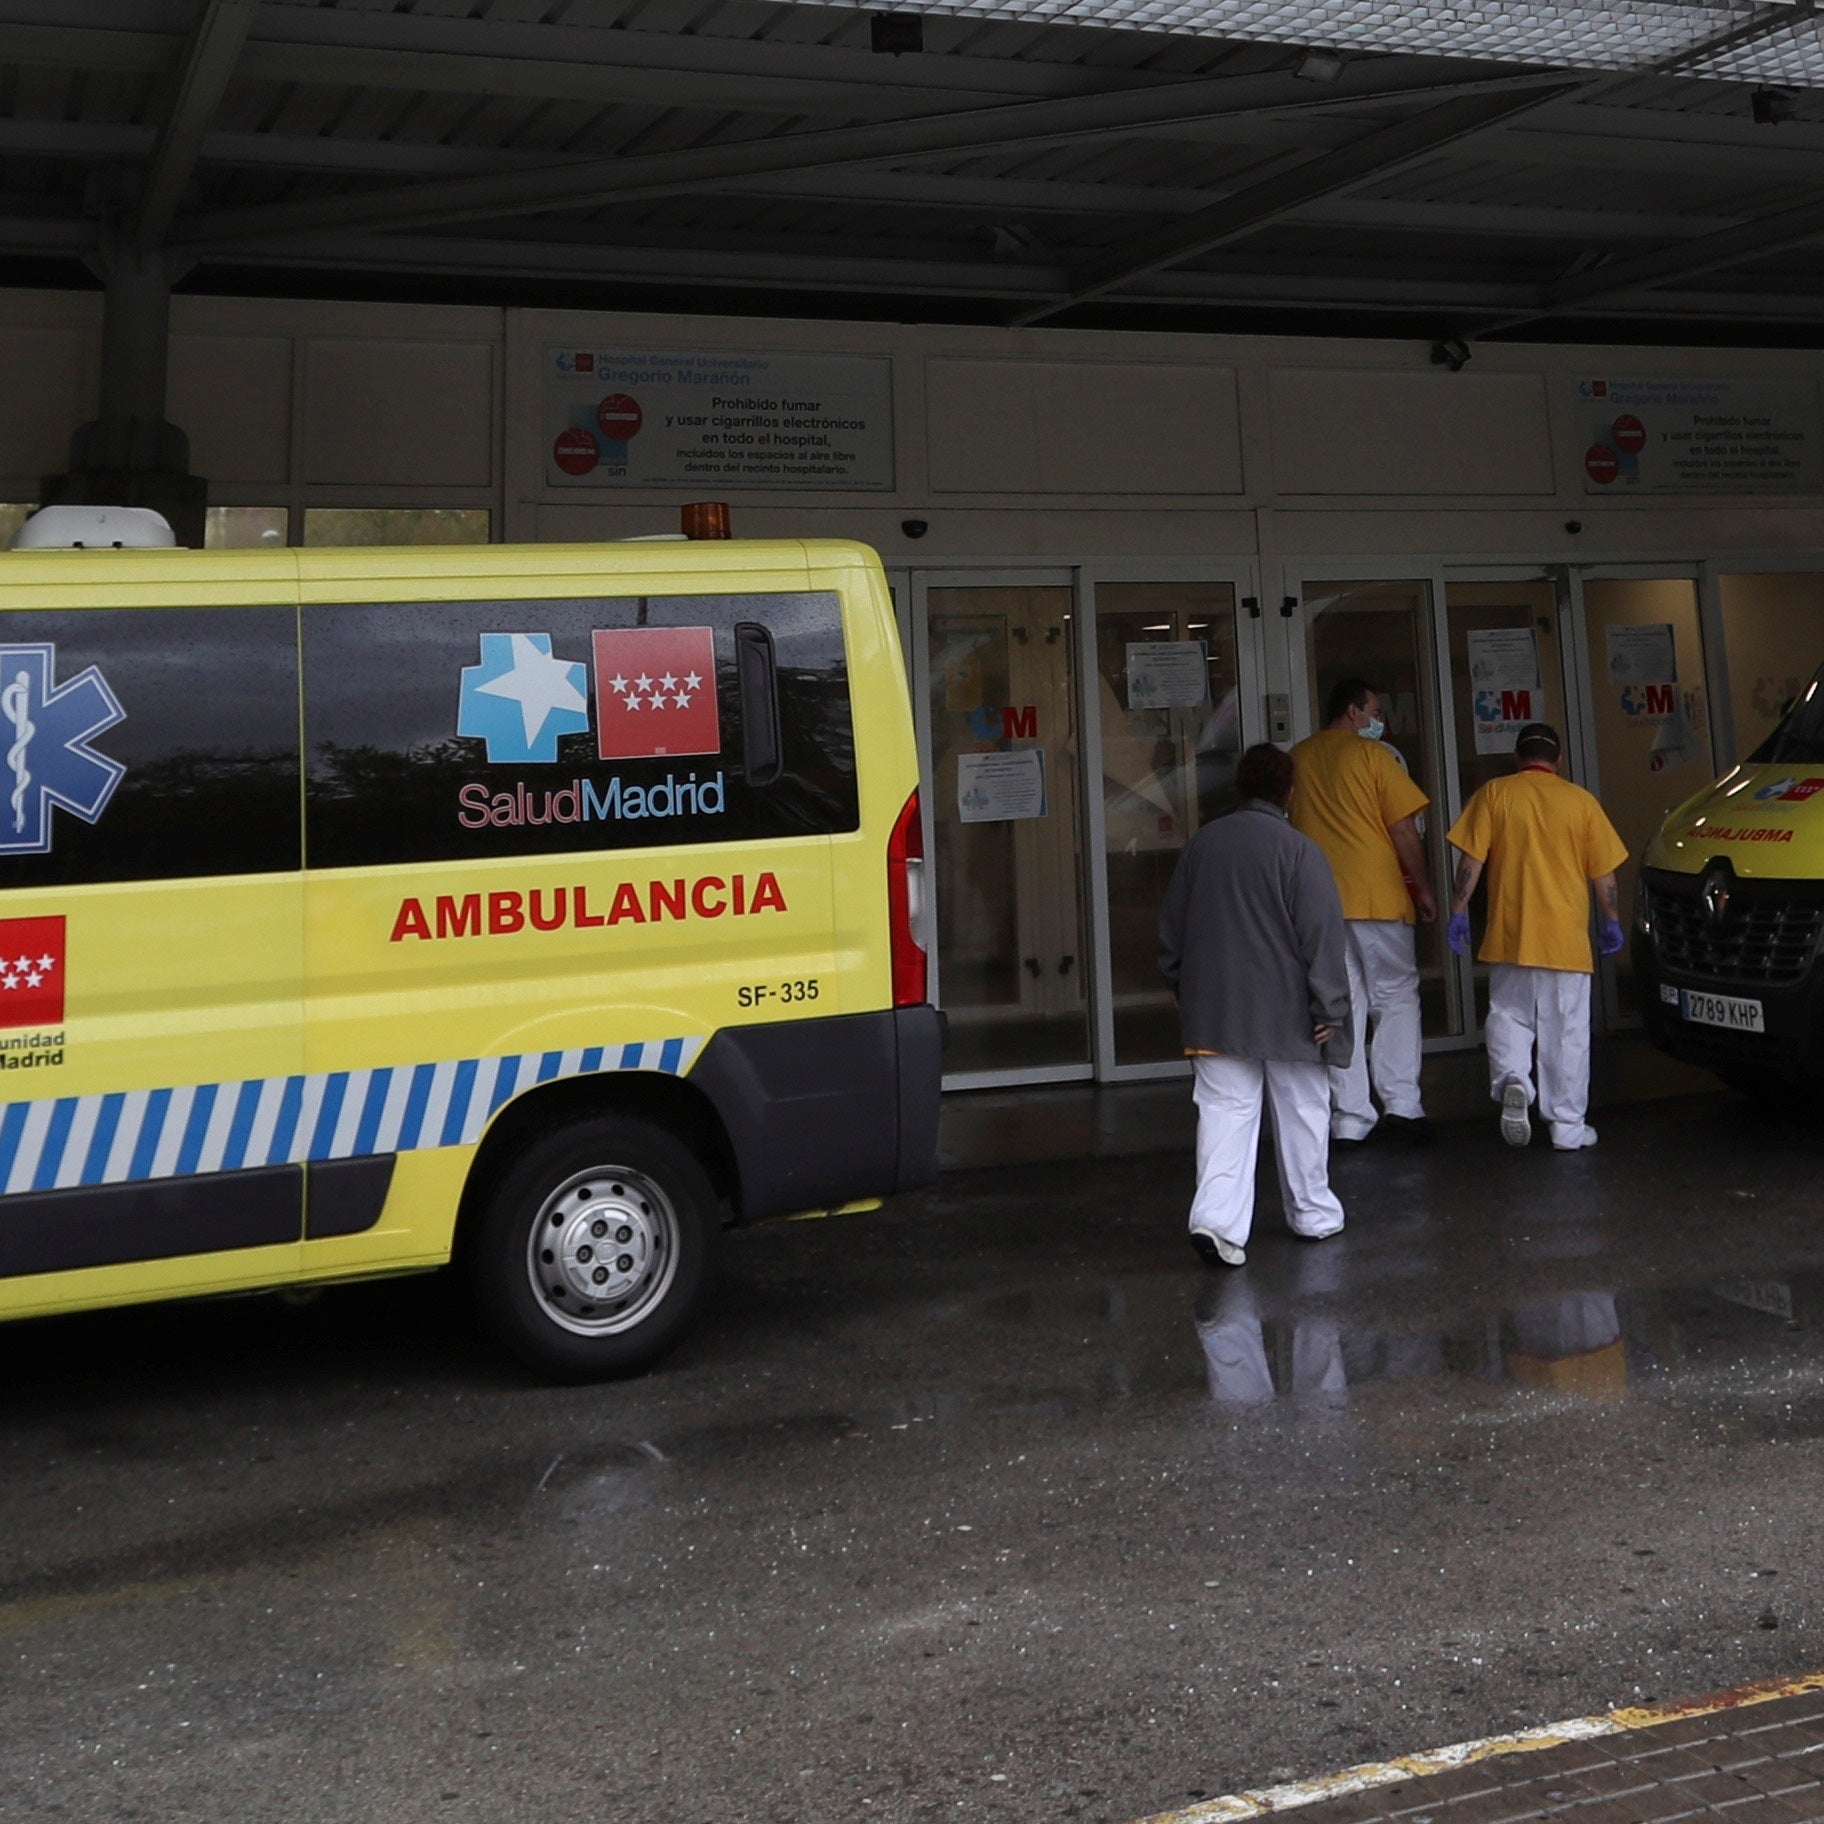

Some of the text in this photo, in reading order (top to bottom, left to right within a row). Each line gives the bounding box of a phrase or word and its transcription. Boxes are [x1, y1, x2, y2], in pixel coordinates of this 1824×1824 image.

[598, 354, 646, 368] Hospital
[649, 355, 695, 368] General
[597, 367, 673, 386] Gregorio
[712, 397, 821, 412] Prohibido fumar
[665, 416, 866, 430] y usar cigarrillos electrónicos
[702, 433, 831, 448] en todo el hospital,
[457, 770, 726, 829] SaludMadrid
[389, 871, 789, 943] AMBULANCIA
[737, 979, 819, 1008] SF-335
[1689, 994, 1759, 1028] 2789 KHP
